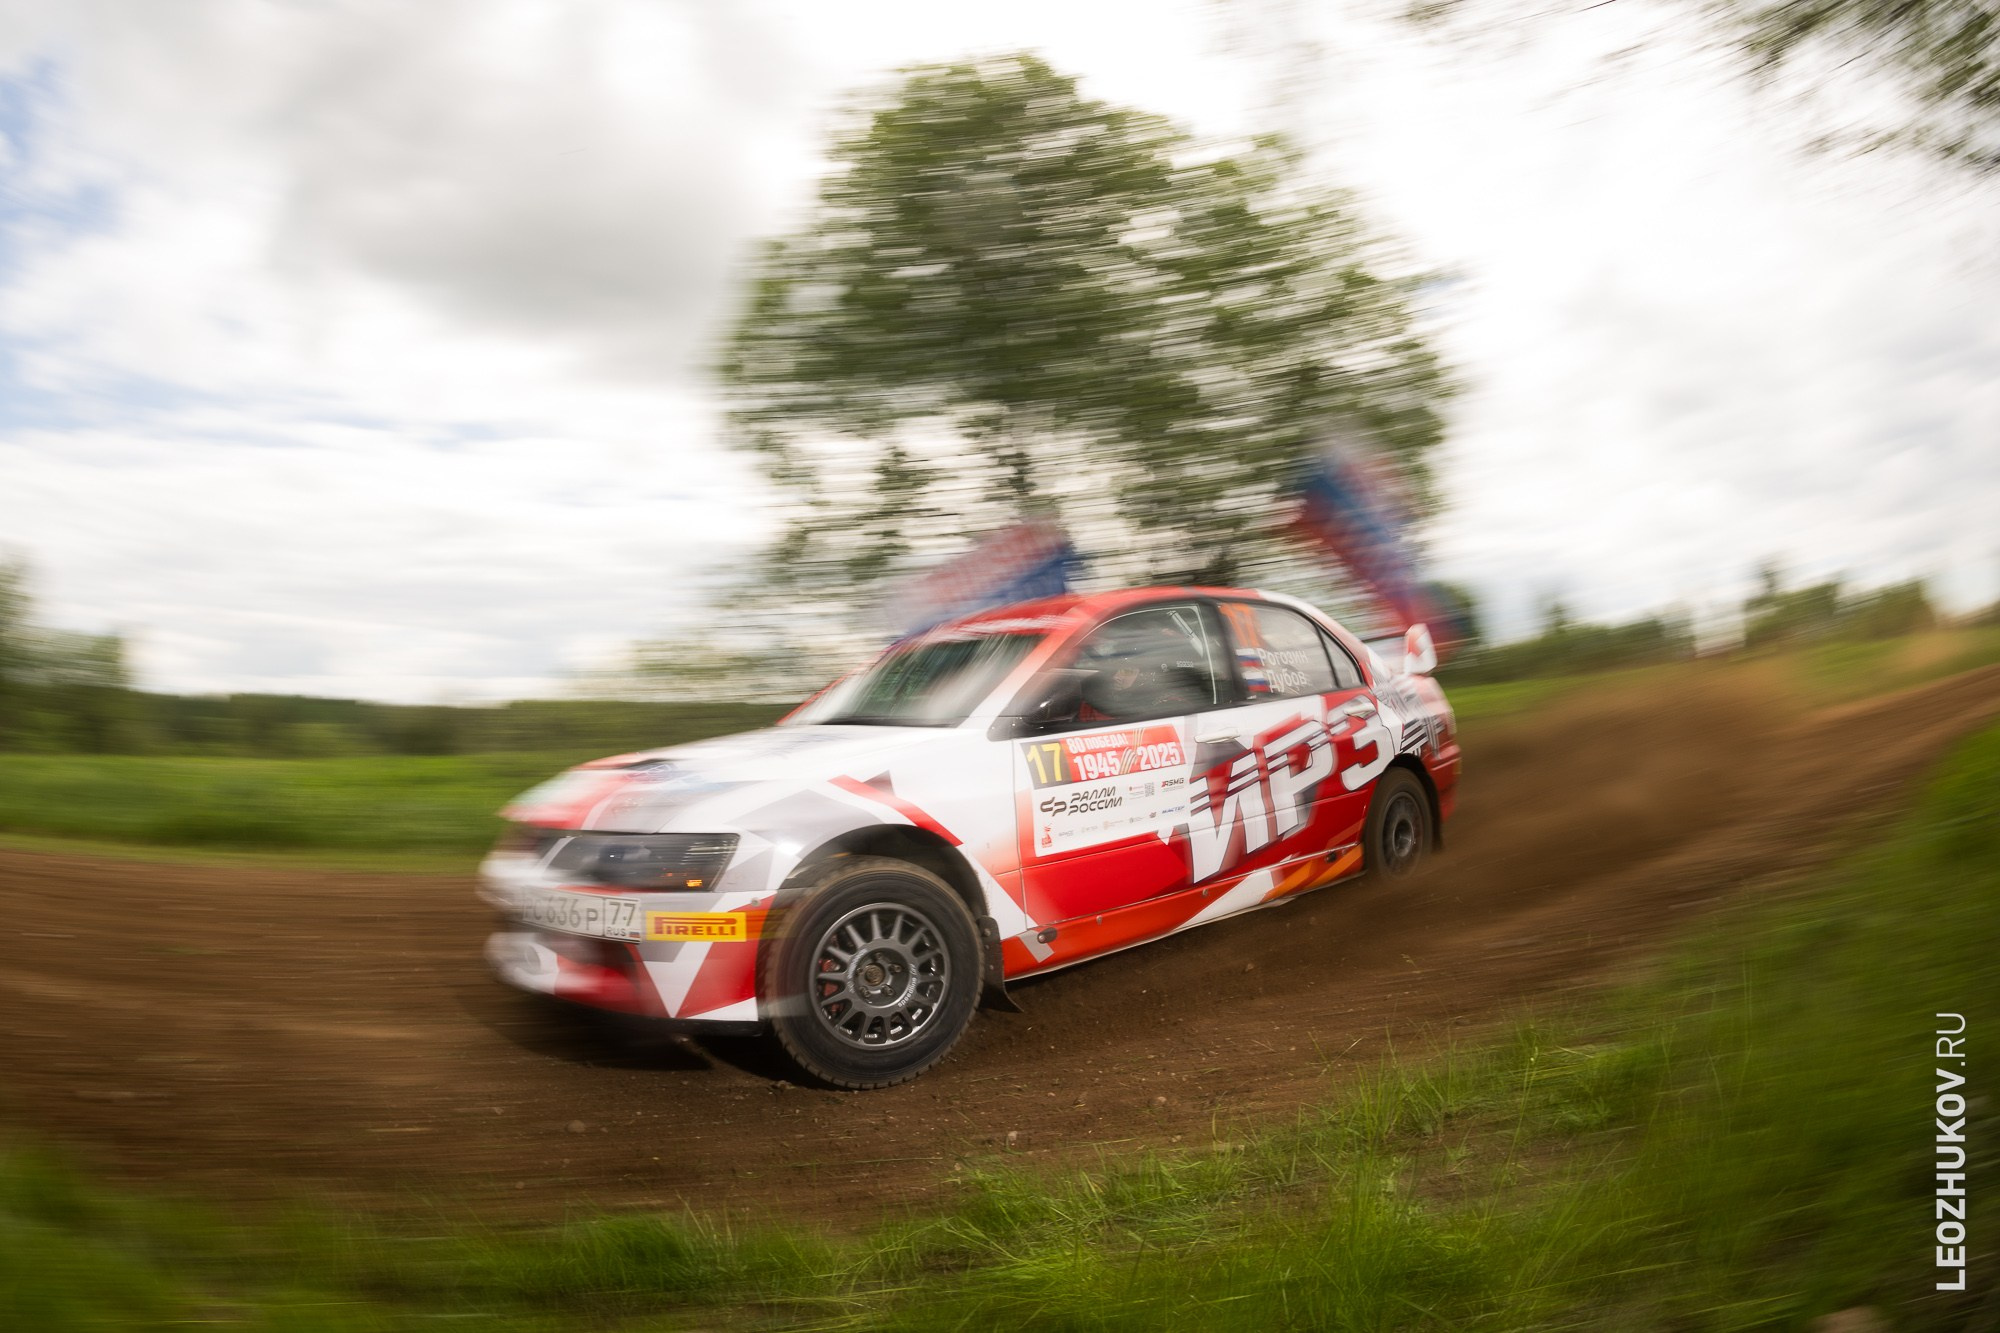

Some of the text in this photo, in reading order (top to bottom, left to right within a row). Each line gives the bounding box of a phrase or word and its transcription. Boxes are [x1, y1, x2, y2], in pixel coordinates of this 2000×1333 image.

[1219, 602, 1261, 648] 17
[1256, 648, 1308, 667] Рогозин
[1266, 669, 1307, 693] Дубов
[1066, 733, 1129, 755] 80 ПОБЕДА!
[1027, 742, 1063, 784] 17
[1073, 742, 1181, 781] 1945 2025
[1068, 796, 1123, 816] РОССИИ
[1071, 786, 1117, 804] РАЛЛИ
[608, 901, 637, 927] 77
[606, 926, 627, 937] RUS
[654, 916, 738, 936] PIRELLI
